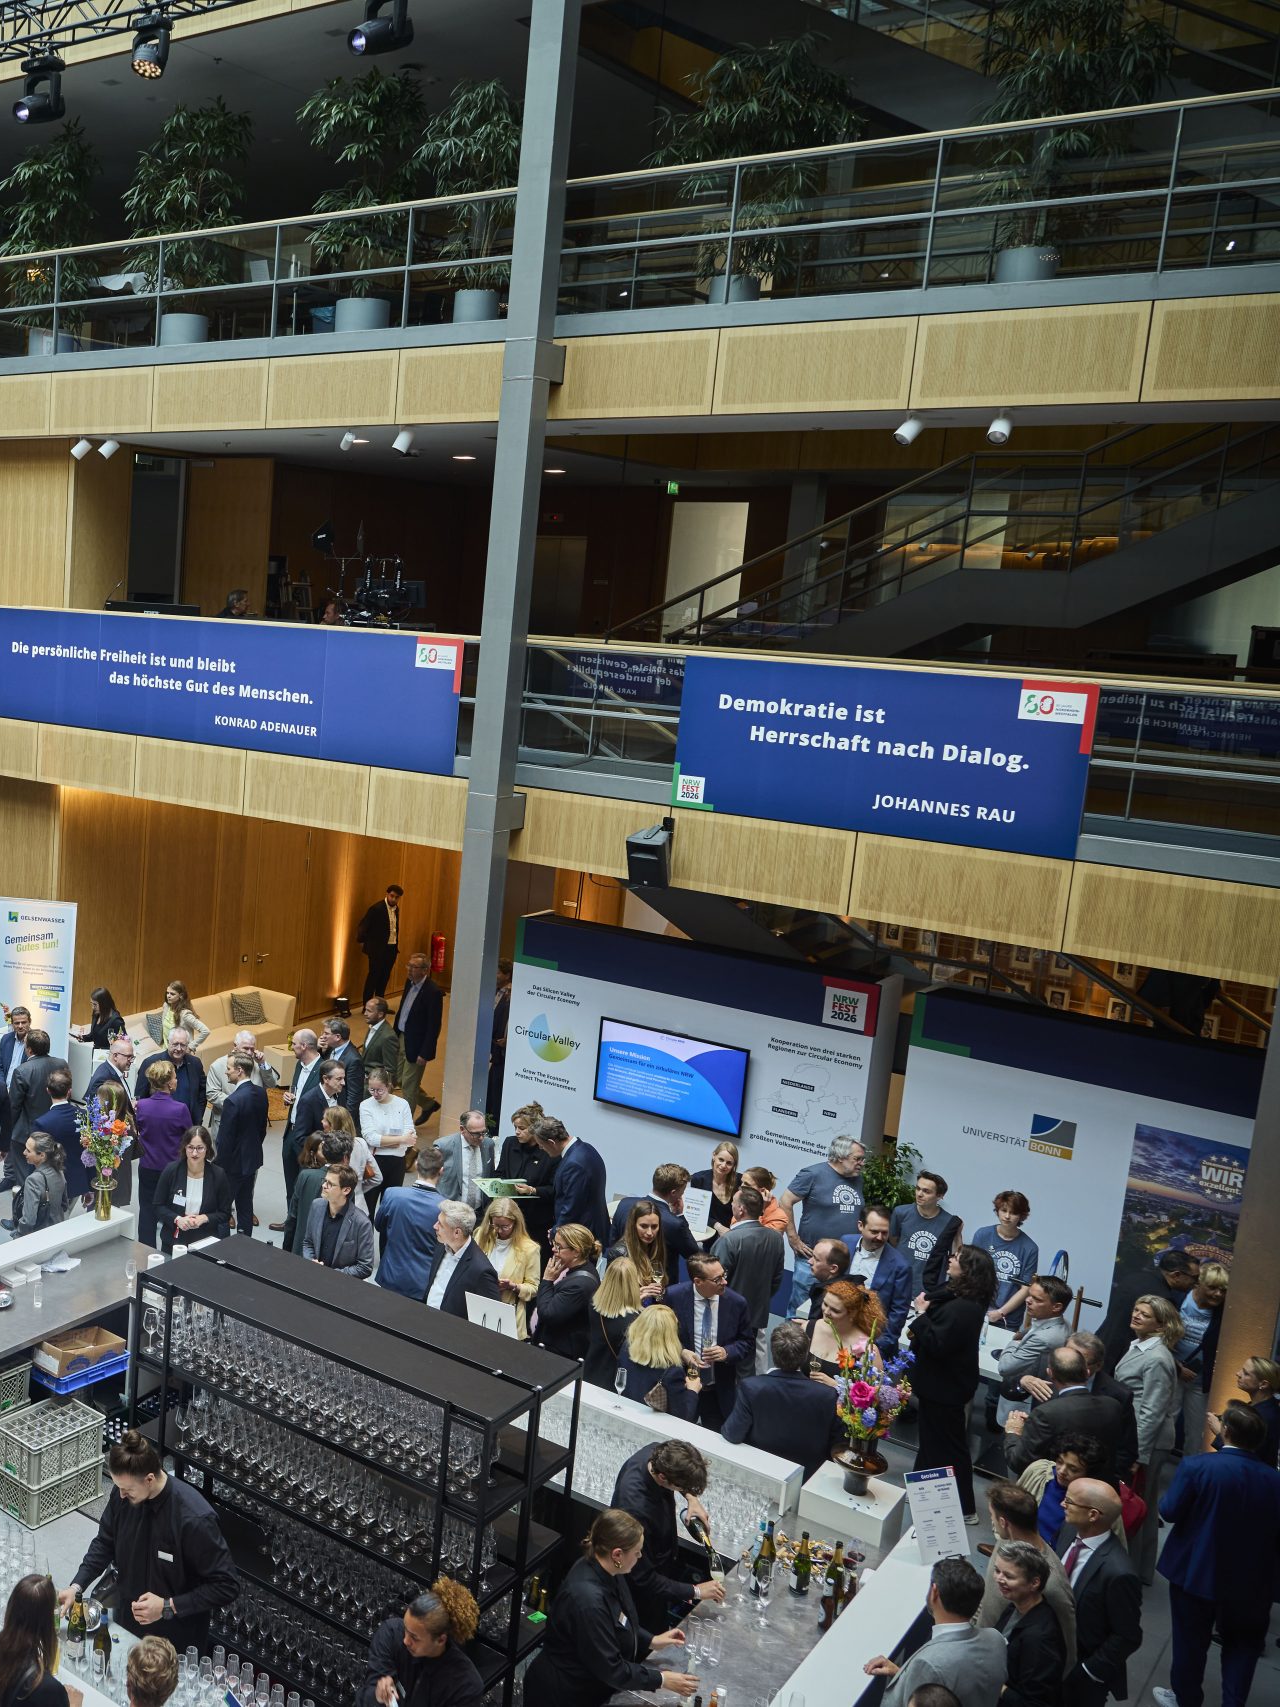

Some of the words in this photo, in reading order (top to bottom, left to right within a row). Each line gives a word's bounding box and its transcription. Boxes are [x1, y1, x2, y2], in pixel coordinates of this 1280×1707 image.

[11, 641, 29, 654] Die
[31, 645, 97, 660] persönliche
[100, 649, 147, 665] Freiheit
[150, 652, 167, 667] ist
[169, 656, 194, 669] und
[197, 657, 236, 673] bleibt
[109, 671, 130, 685] das
[133, 673, 182, 691] höchste
[186, 679, 209, 693] Gut
[212, 681, 235, 696] des
[239, 684, 314, 705] Menschen.
[718, 693, 849, 721] Demokratie
[854, 704, 886, 724] ist
[214, 715, 257, 729] KONRAD
[260, 721, 317, 737] ADENAUER
[749, 725, 871, 753] Herrschaft
[877, 741, 935, 760] nach
[942, 744, 1029, 773] Dialog.
[681, 784, 700, 793] FEST
[681, 791, 699, 800] 2026
[872, 794, 971, 818] JOHANNES
[976, 806, 1016, 823] RAU
[4, 932, 54, 945] Gemeinsam
[16, 942, 40, 952] Gutes
[42, 938, 59, 949] tun!
[831, 1001, 858, 1014] FEST
[832, 993, 859, 1005] NRW
[830, 1010, 857, 1023] 2026
[514, 1025, 551, 1042] Circular
[552, 1033, 581, 1050] Valley
[629, 1050, 651, 1061] Mission
[767, 1043, 796, 1054] Regionen
[808, 1052, 832, 1062] Circular
[833, 1057, 863, 1070] Economy
[770, 1036, 809, 1050] Kooperation
[822, 1048, 835, 1056] drei
[836, 1052, 861, 1062] starken
[749, 1133, 774, 1144] größten
[765, 1129, 801, 1144] Gemeinsam
[801, 1139, 815, 1148] eine
[962, 1125, 1028, 1148] UNIVERSITÄT
[1030, 1142, 1061, 1157] BONN
[1201, 1165, 1244, 1189] WIR
[832, 1196, 840, 1204] 18
[920, 1472, 940, 1480] Getränke
